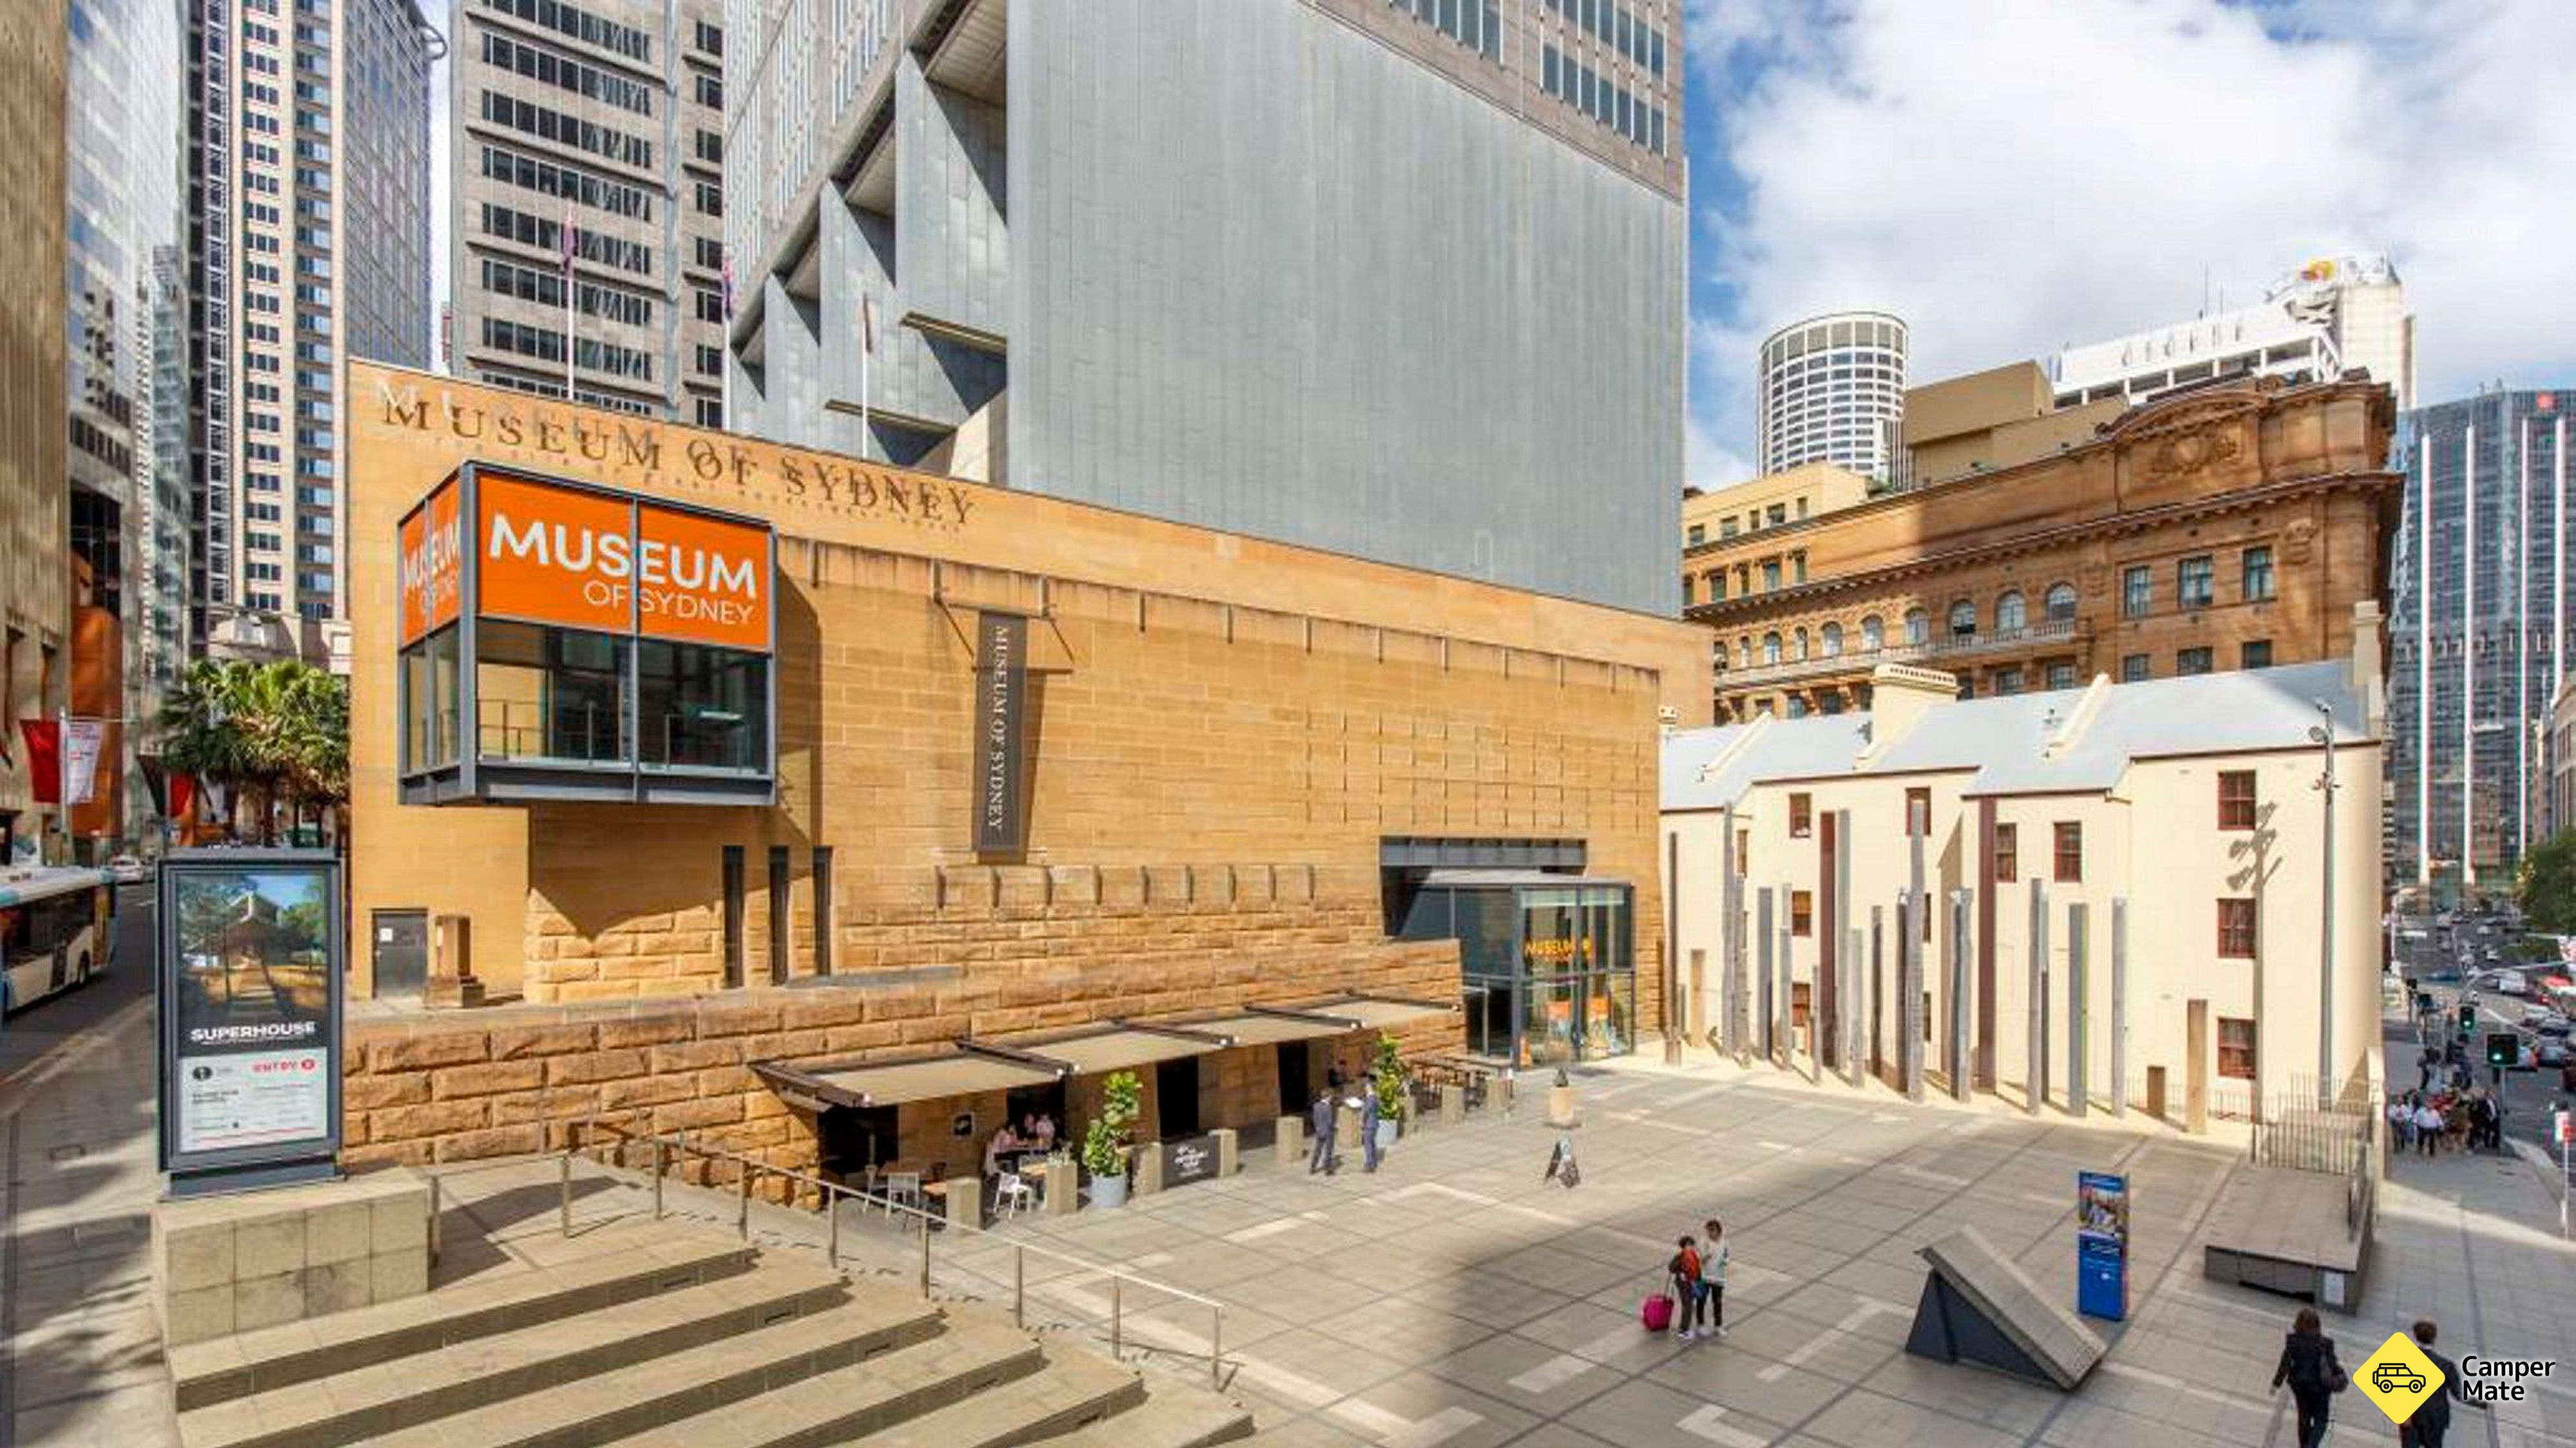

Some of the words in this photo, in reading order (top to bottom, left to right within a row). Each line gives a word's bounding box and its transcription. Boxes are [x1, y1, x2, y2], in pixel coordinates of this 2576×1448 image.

[379, 385, 663, 470] MUSEUM
[687, 439, 758, 485] OF
[781, 454, 975, 524] SYDNEY
[489, 512, 757, 599] MUSEUM
[583, 580, 628, 610] OF
[639, 589, 754, 625] SYDNEY
[993, 625, 1009, 713] MUSEUM
[991, 720, 1007, 745] OF
[989, 751, 1005, 830] SYDNEY
[191, 1021, 316, 1042] SUPERHOUSE
